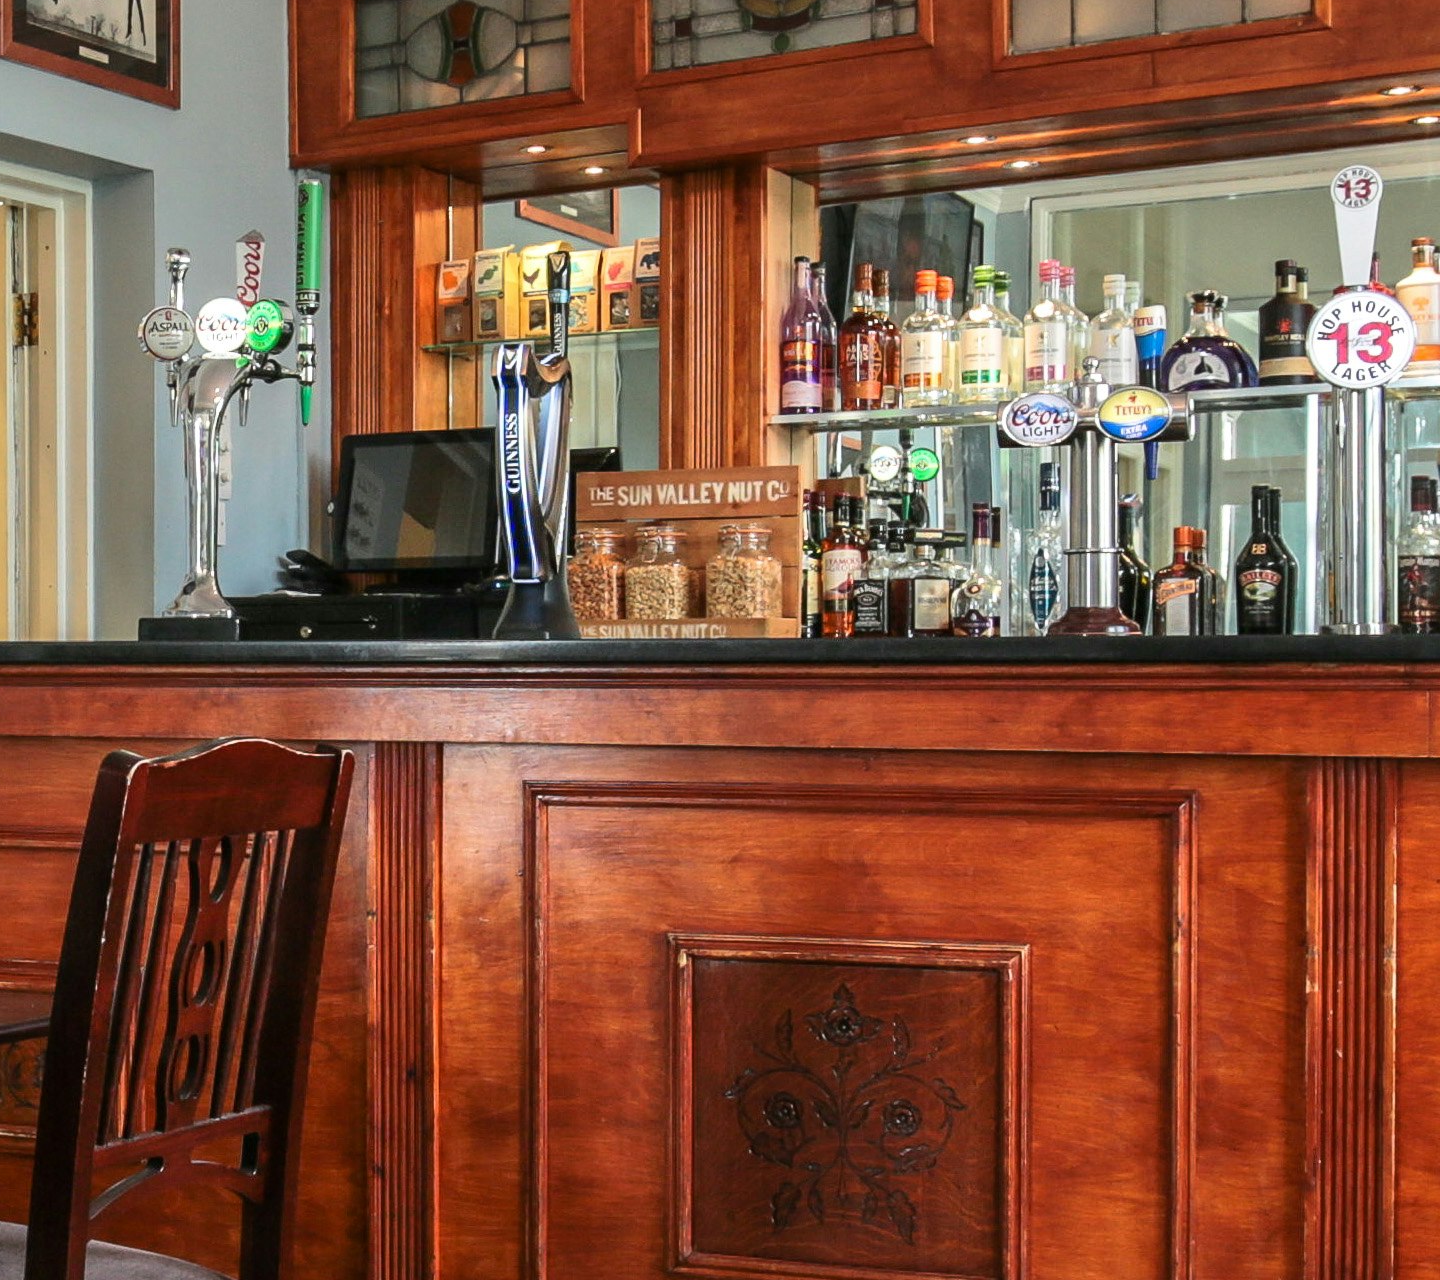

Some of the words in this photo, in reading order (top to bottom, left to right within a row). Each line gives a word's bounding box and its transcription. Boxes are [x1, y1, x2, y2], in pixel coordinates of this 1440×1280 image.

[1343, 179, 1371, 199] 13
[149, 321, 189, 333] ASPALL
[1317, 308, 1342, 341] HOP
[1351, 301, 1405, 336] HOUSE
[552, 312, 562, 355] GUINNESS
[1327, 321, 1394, 365] 13
[1331, 362, 1393, 381] LAGER
[1011, 403, 1071, 427] Coors
[1022, 425, 1061, 438] LIGHT
[1120, 423, 1148, 436] EXTRA
[505, 412, 521, 494] GUINNESS
[589, 486, 614, 502] THE
[617, 485, 652, 506] SUN
[656, 482, 724, 505] VALLEY
[728, 481, 764, 503] NUT
[599, 624, 627, 638] SUN
[628, 624, 678, 638] VALLEY
[681, 623, 708, 638] NUT
